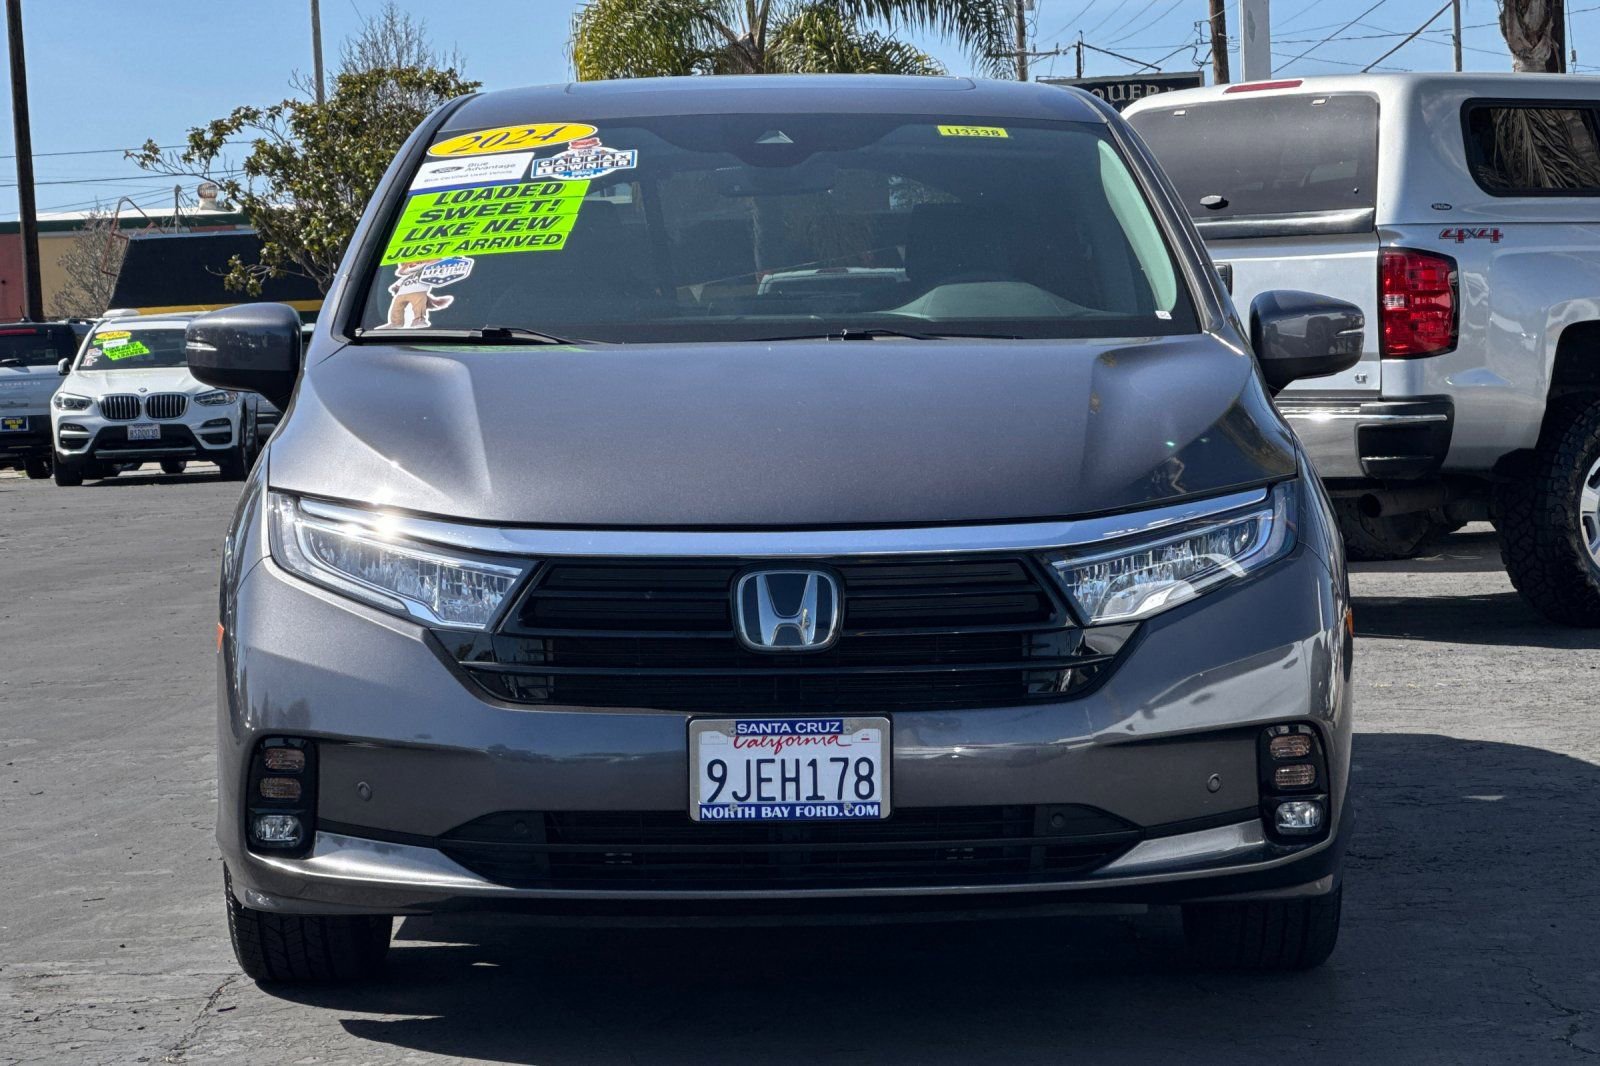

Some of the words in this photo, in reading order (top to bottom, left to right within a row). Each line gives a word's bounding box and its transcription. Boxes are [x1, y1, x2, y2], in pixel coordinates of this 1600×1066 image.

[449, 125, 567, 153] 2024
[946, 128, 1001, 137] U3338
[540, 154, 630, 167] CARFAX
[554, 161, 628, 172] OWNER
[433, 182, 566, 206] LOADED
[415, 199, 563, 224] SWEET!
[402, 221, 476, 243] LIKE
[481, 215, 562, 234] NEW
[386, 242, 451, 261] JUST
[452, 233, 563, 253] ARRIVED
[737, 722, 791, 734] SANTA
[795, 721, 840, 733] CRUZ
[733, 735, 852, 755] California
[706, 757, 875, 803] 9JEH178
[701, 806, 756, 819] NORTH
[761, 805, 790, 818] BAY
[795, 804, 879, 817] FORD.COM
